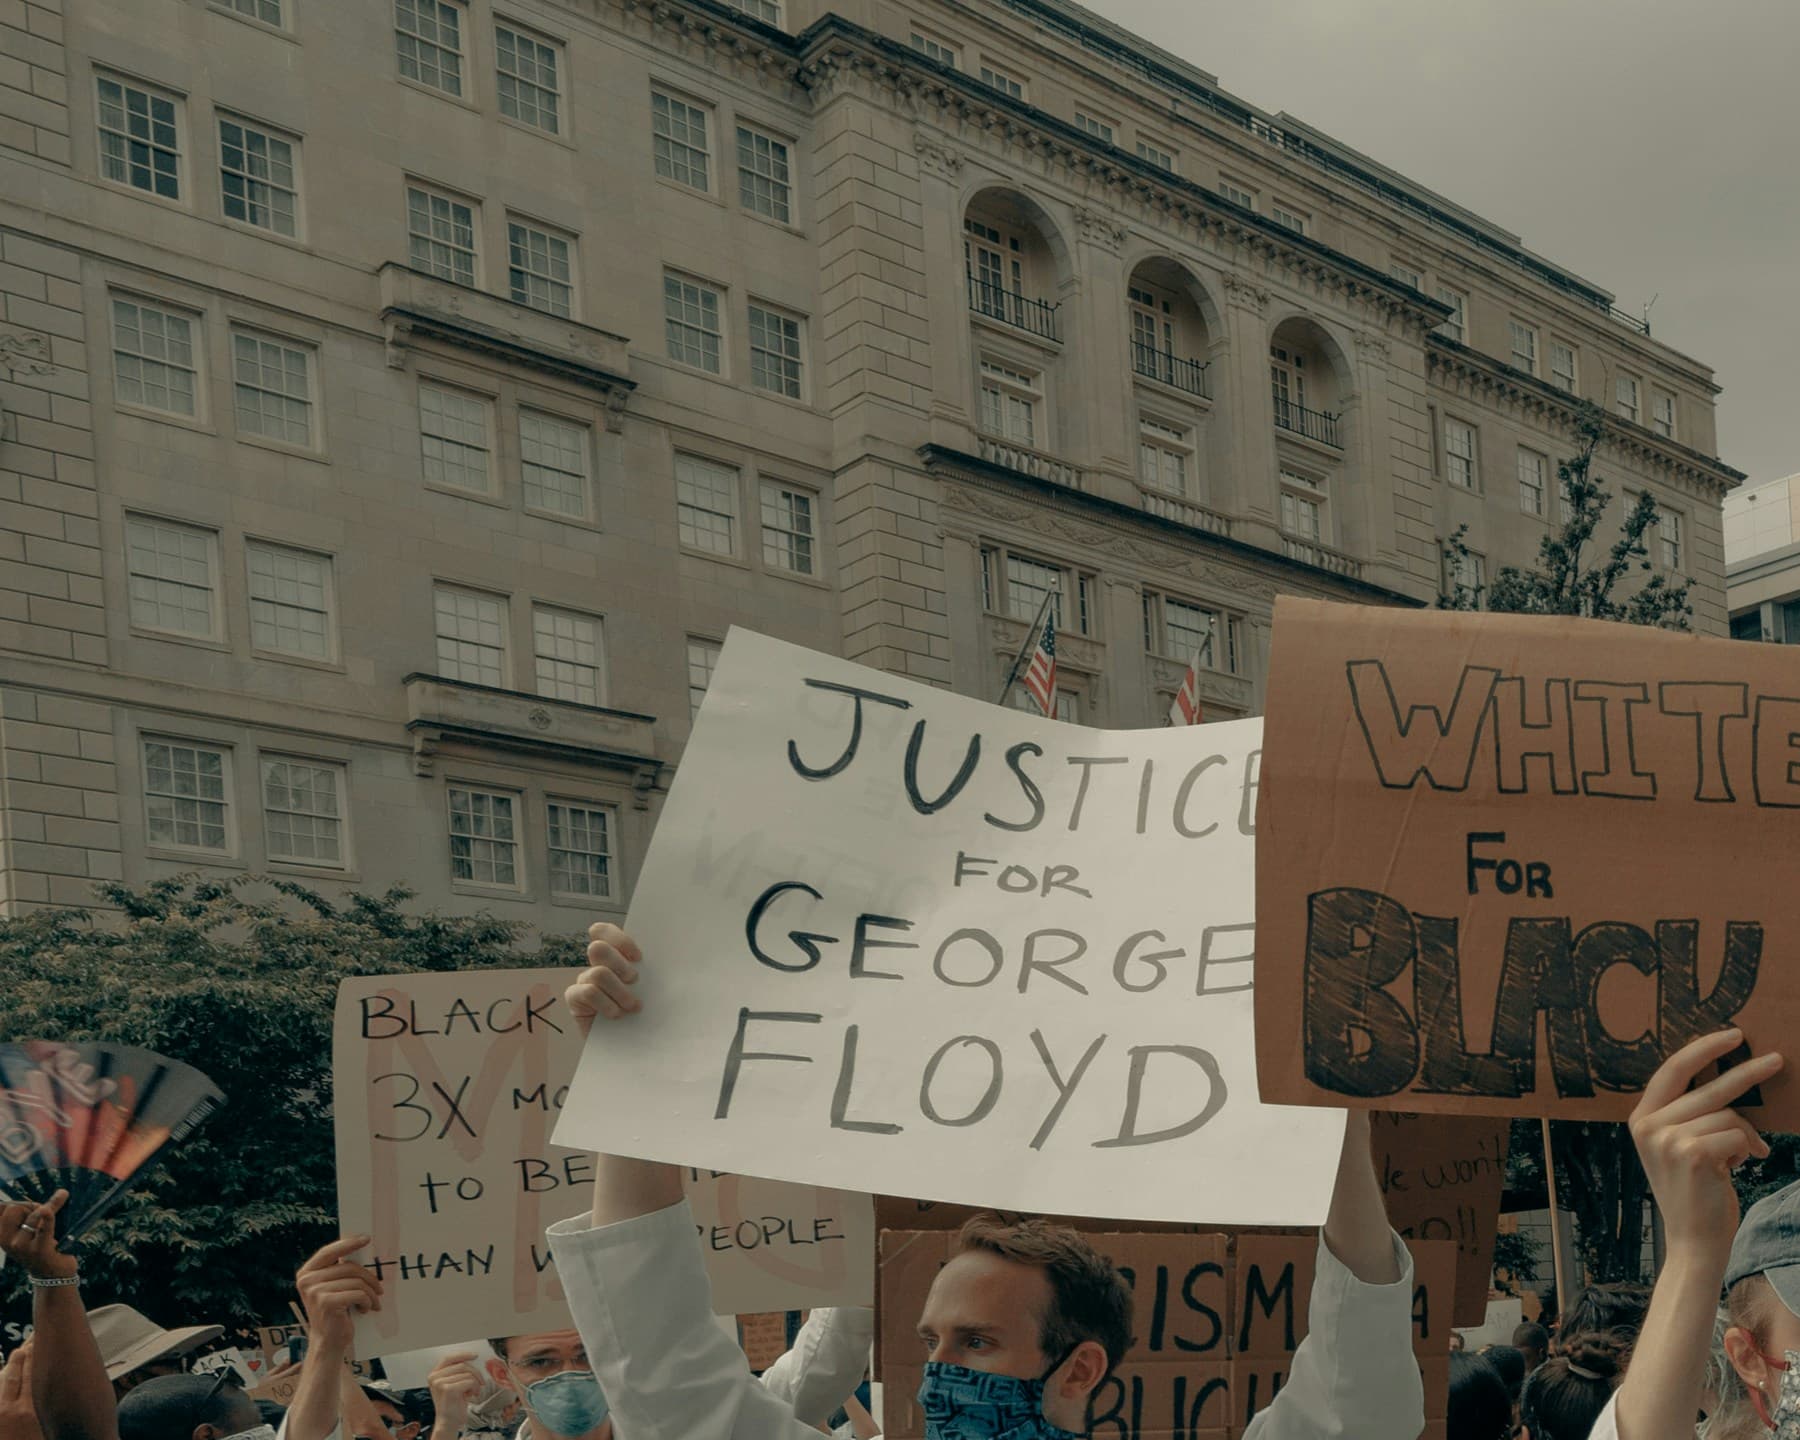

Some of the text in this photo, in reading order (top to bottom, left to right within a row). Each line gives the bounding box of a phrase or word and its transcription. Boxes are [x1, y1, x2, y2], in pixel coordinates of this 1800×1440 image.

[954, 851, 1092, 898] FOR
[746, 881, 1255, 996] GEORGE
[360, 994, 564, 1040] BLACK
[1302, 886, 1765, 1108] BLACK
[372, 1073, 478, 1141] 3X
[714, 1007, 1228, 1151] FLOYD
[513, 1155, 596, 1192] BE
[697, 1217, 845, 1252] EOPLE
[1117, 1261, 1296, 1352] ISM
